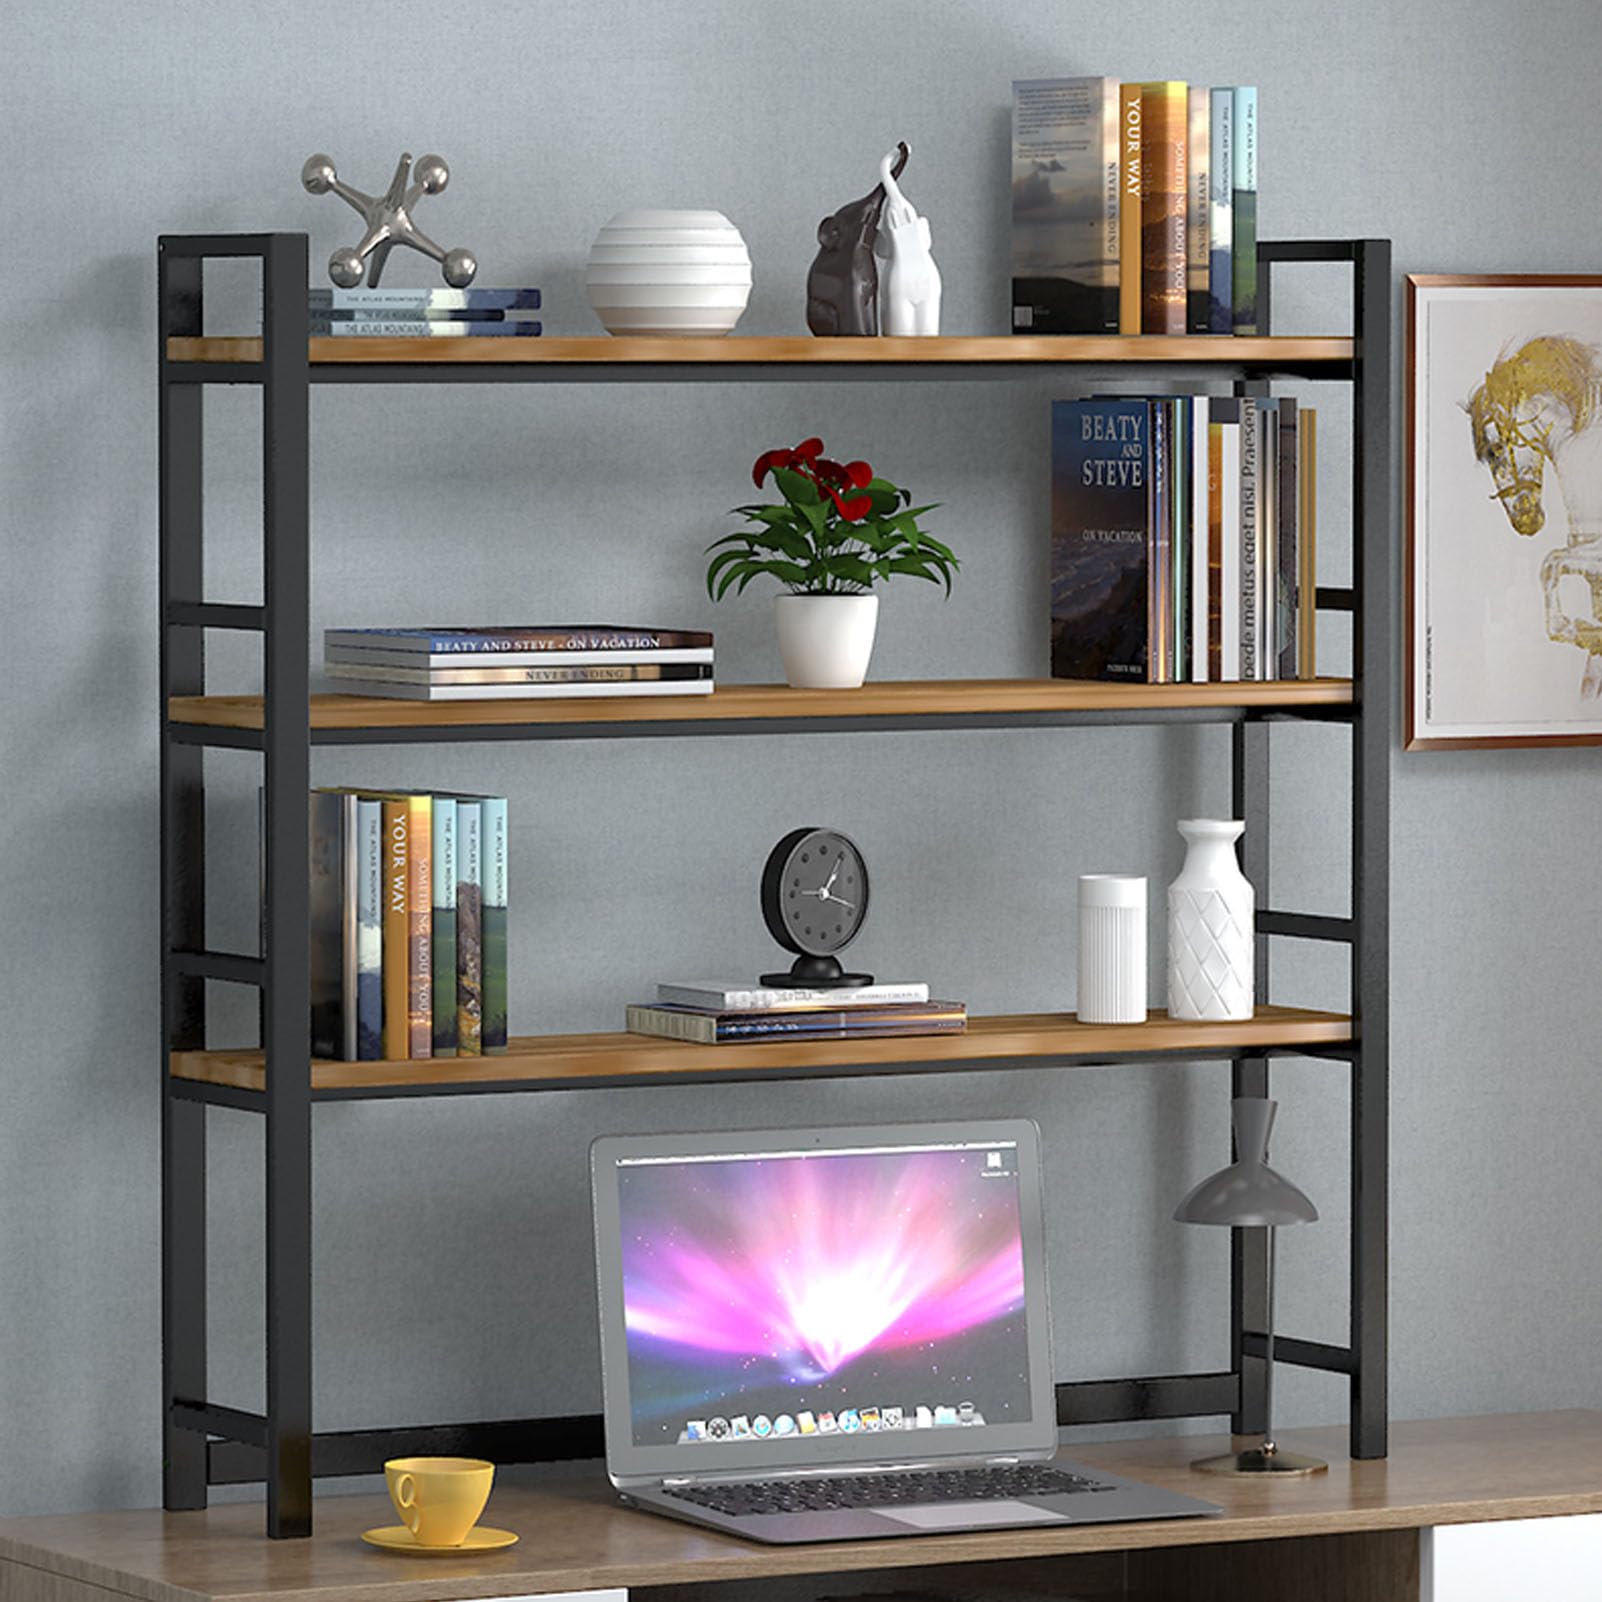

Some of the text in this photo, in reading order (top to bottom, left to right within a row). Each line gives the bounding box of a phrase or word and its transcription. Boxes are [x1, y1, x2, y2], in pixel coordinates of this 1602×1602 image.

[1127, 98, 1141, 197] YOUR WAY
[1107, 162, 1117, 253] NEVER ENDING
[1175, 140, 1185, 290] SOMETHING ABOUT YOU
[1198, 172, 1207, 259] NEVER ENDING
[1081, 415, 1143, 441] BEATY
[1082, 459, 1143, 486] STEVE
[1121, 443, 1143, 458] AND
[1242, 398, 1255, 679] pede metus eget nisi. Praesent
[435, 641, 478, 653] BEATY
[482, 640, 511, 652] AND
[514, 639, 555, 651] STEVE
[566, 638, 587, 650] ON
[591, 637, 661, 649] VACATION
[525, 669, 624, 681] NEVER ENDING
[391, 814, 406, 914] YOUR WAY
[418, 857, 429, 1011] SOMETHING ABOUT YOU
